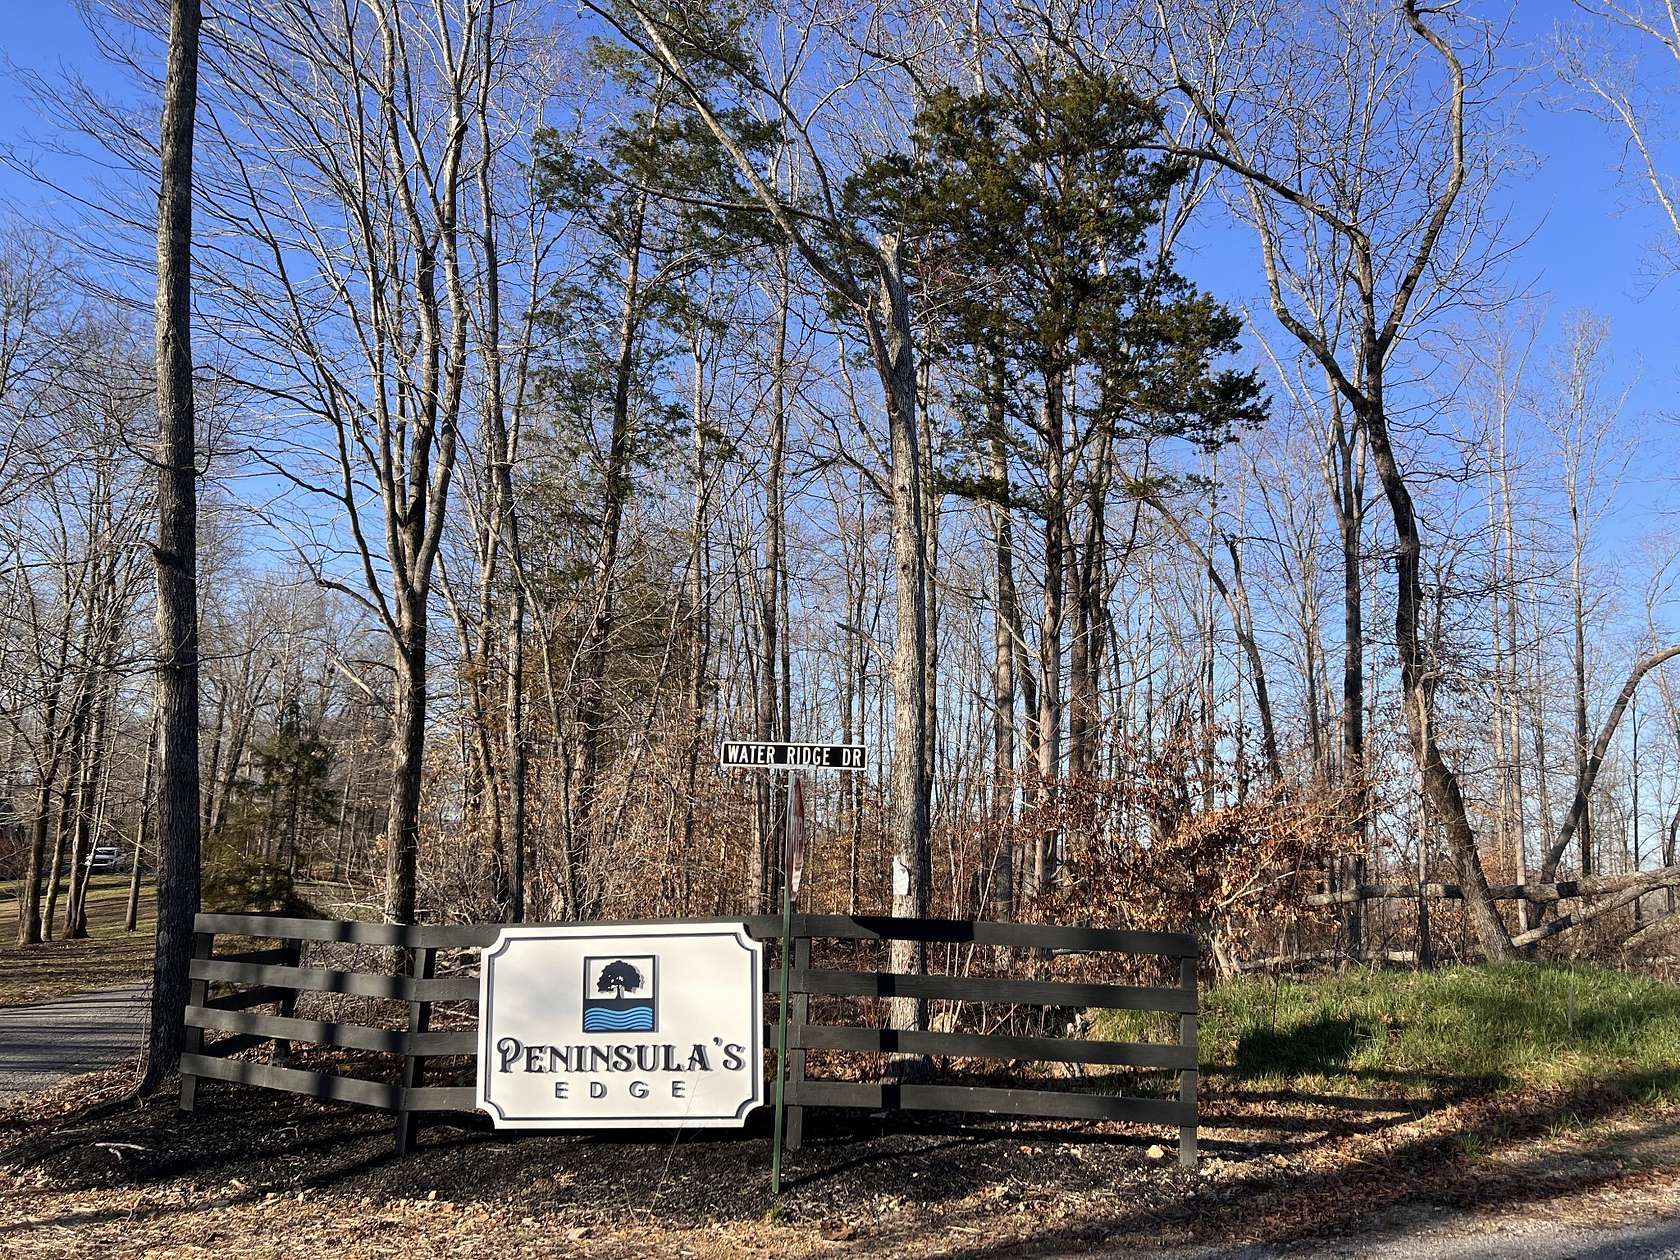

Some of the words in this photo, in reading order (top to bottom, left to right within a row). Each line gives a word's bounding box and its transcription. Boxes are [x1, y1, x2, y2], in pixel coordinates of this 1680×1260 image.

[728, 745, 775, 764] WATER
[786, 747, 831, 766] RIDGE
[842, 748, 861, 767] DR
[496, 1036, 746, 1074] PENINSULA'S
[555, 1080, 686, 1100] EDGE
